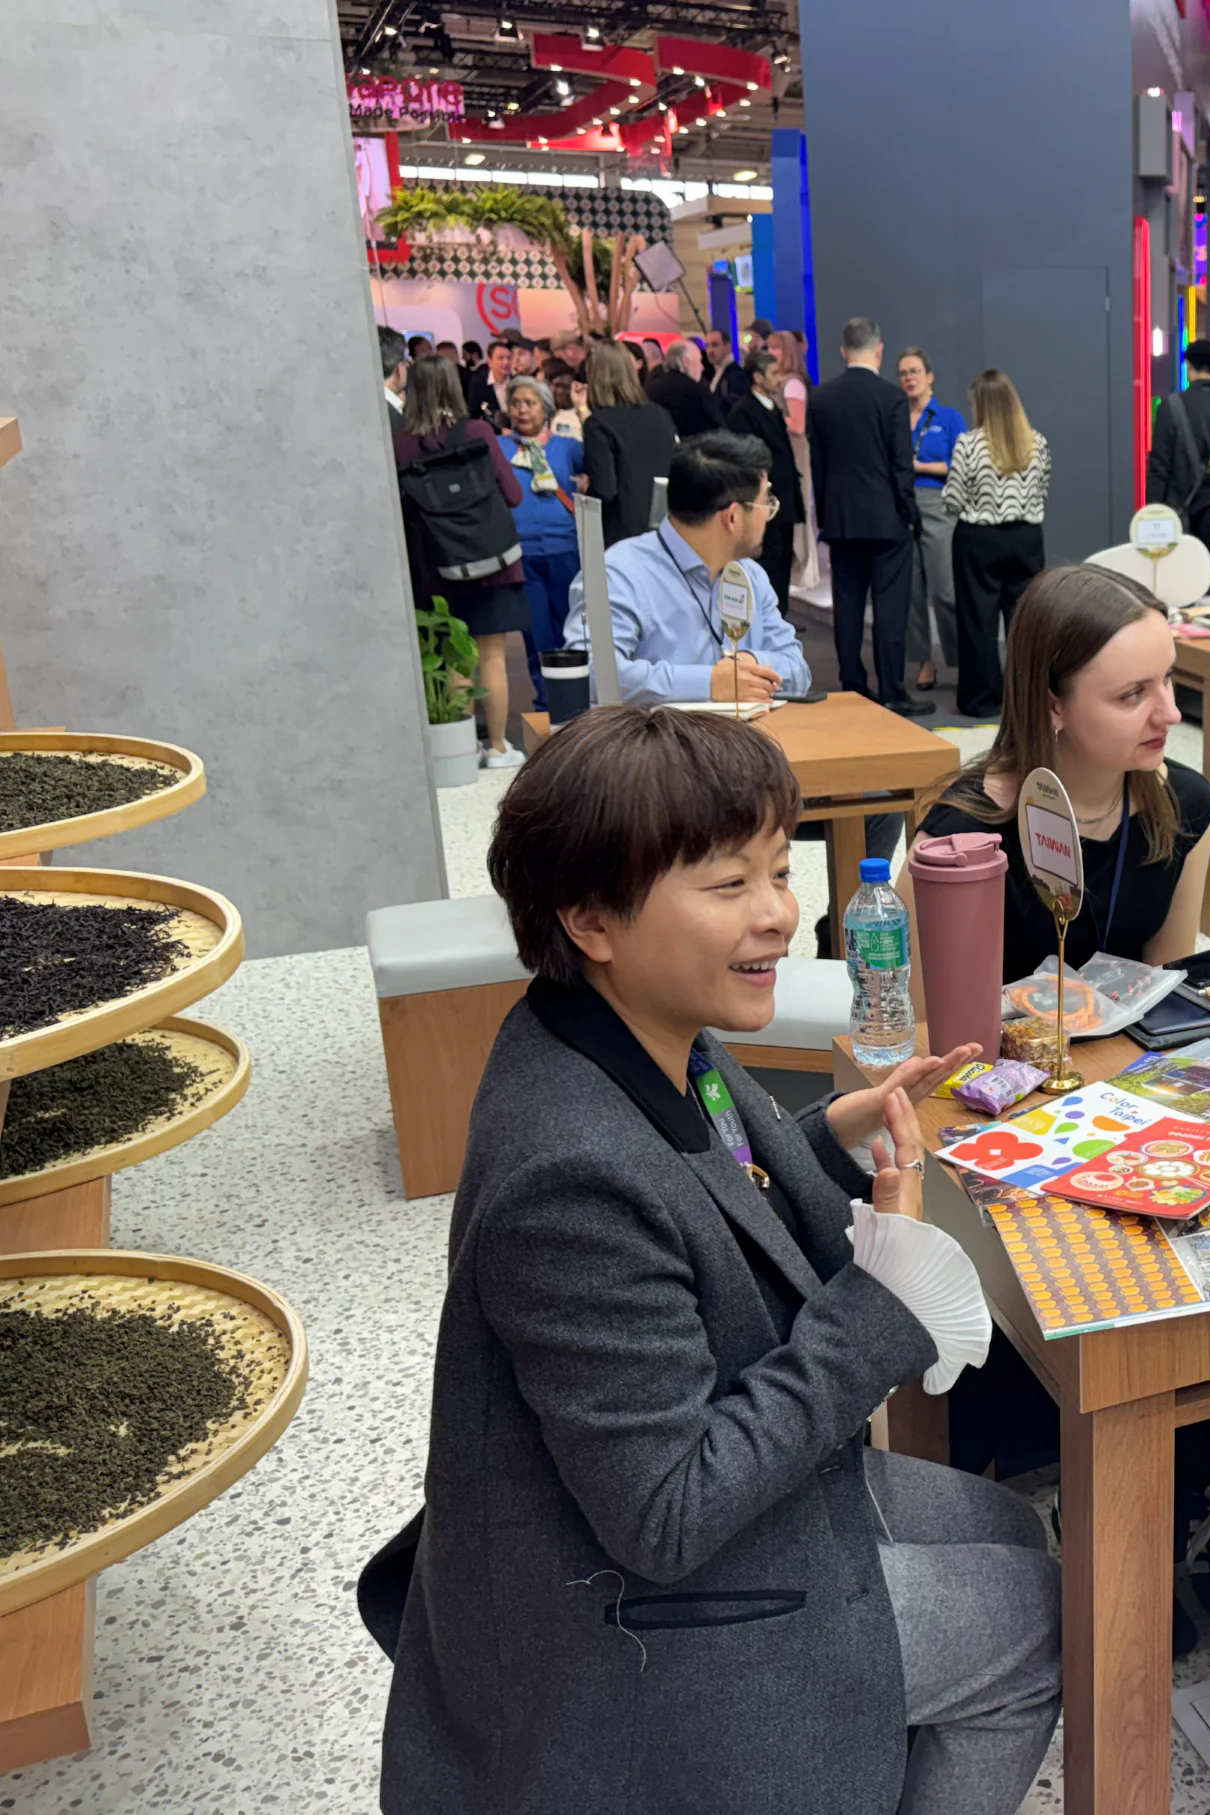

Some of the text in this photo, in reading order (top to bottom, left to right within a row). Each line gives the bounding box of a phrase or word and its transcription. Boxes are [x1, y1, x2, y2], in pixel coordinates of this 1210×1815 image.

[345, 73, 463, 105] apore
[1035, 831, 1071, 859] TAIWAN
[959, 1063, 986, 1082] Ricola
[1100, 1092, 1139, 1109] Color
[725, 1110, 738, 1134] Youth
[1109, 1106, 1152, 1126] Taipei
